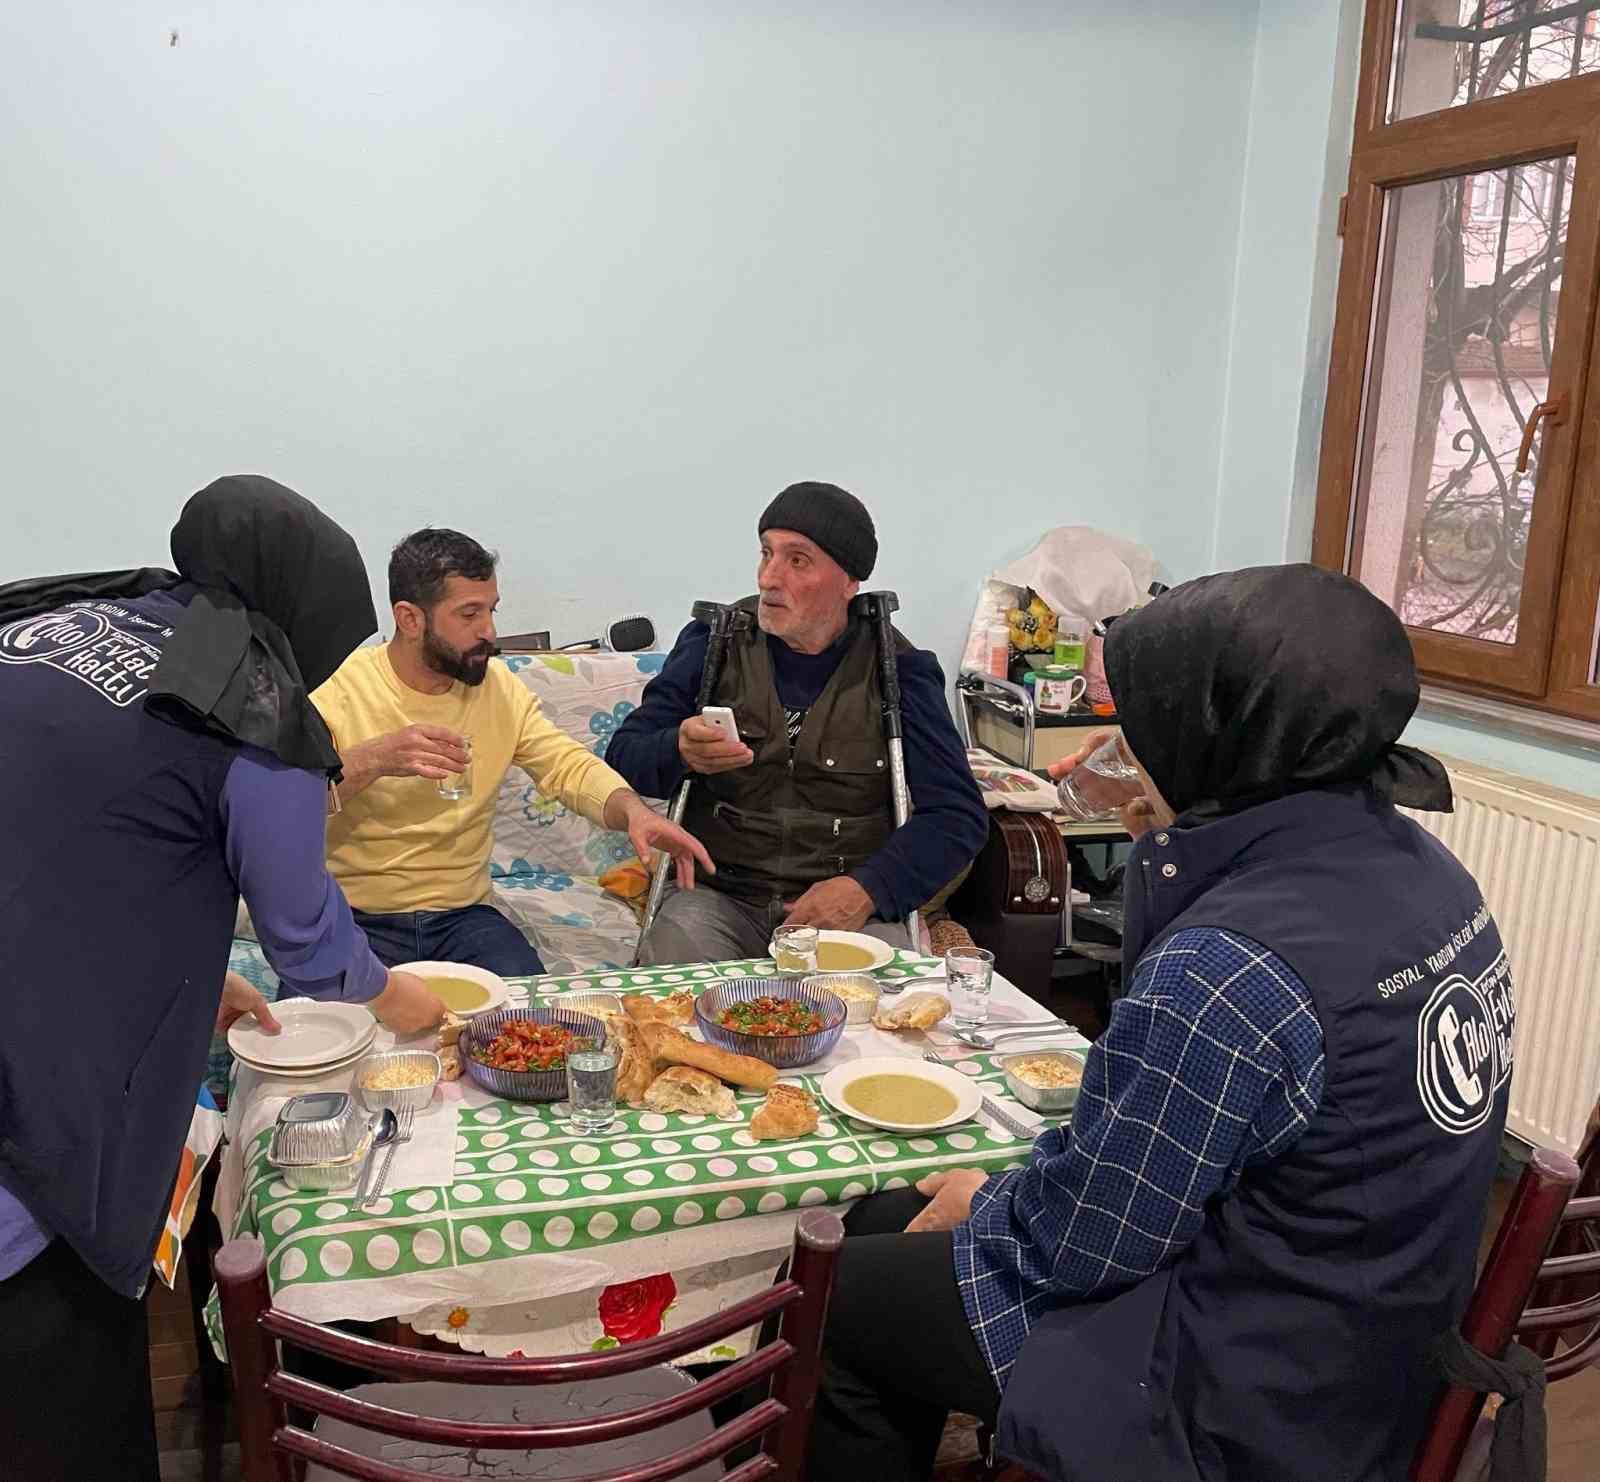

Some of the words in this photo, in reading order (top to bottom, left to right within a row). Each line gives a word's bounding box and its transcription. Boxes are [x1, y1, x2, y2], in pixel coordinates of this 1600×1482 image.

[36, 622, 85, 645] Alo
[92, 638, 157, 680] Evlat
[64, 649, 133, 702] Hattı
[1377, 964, 1425, 998] SOSYAL
[1424, 943, 1456, 974] YARDIM
[1488, 976, 1515, 1031] Evla
[1461, 1016, 1490, 1074] Alo
